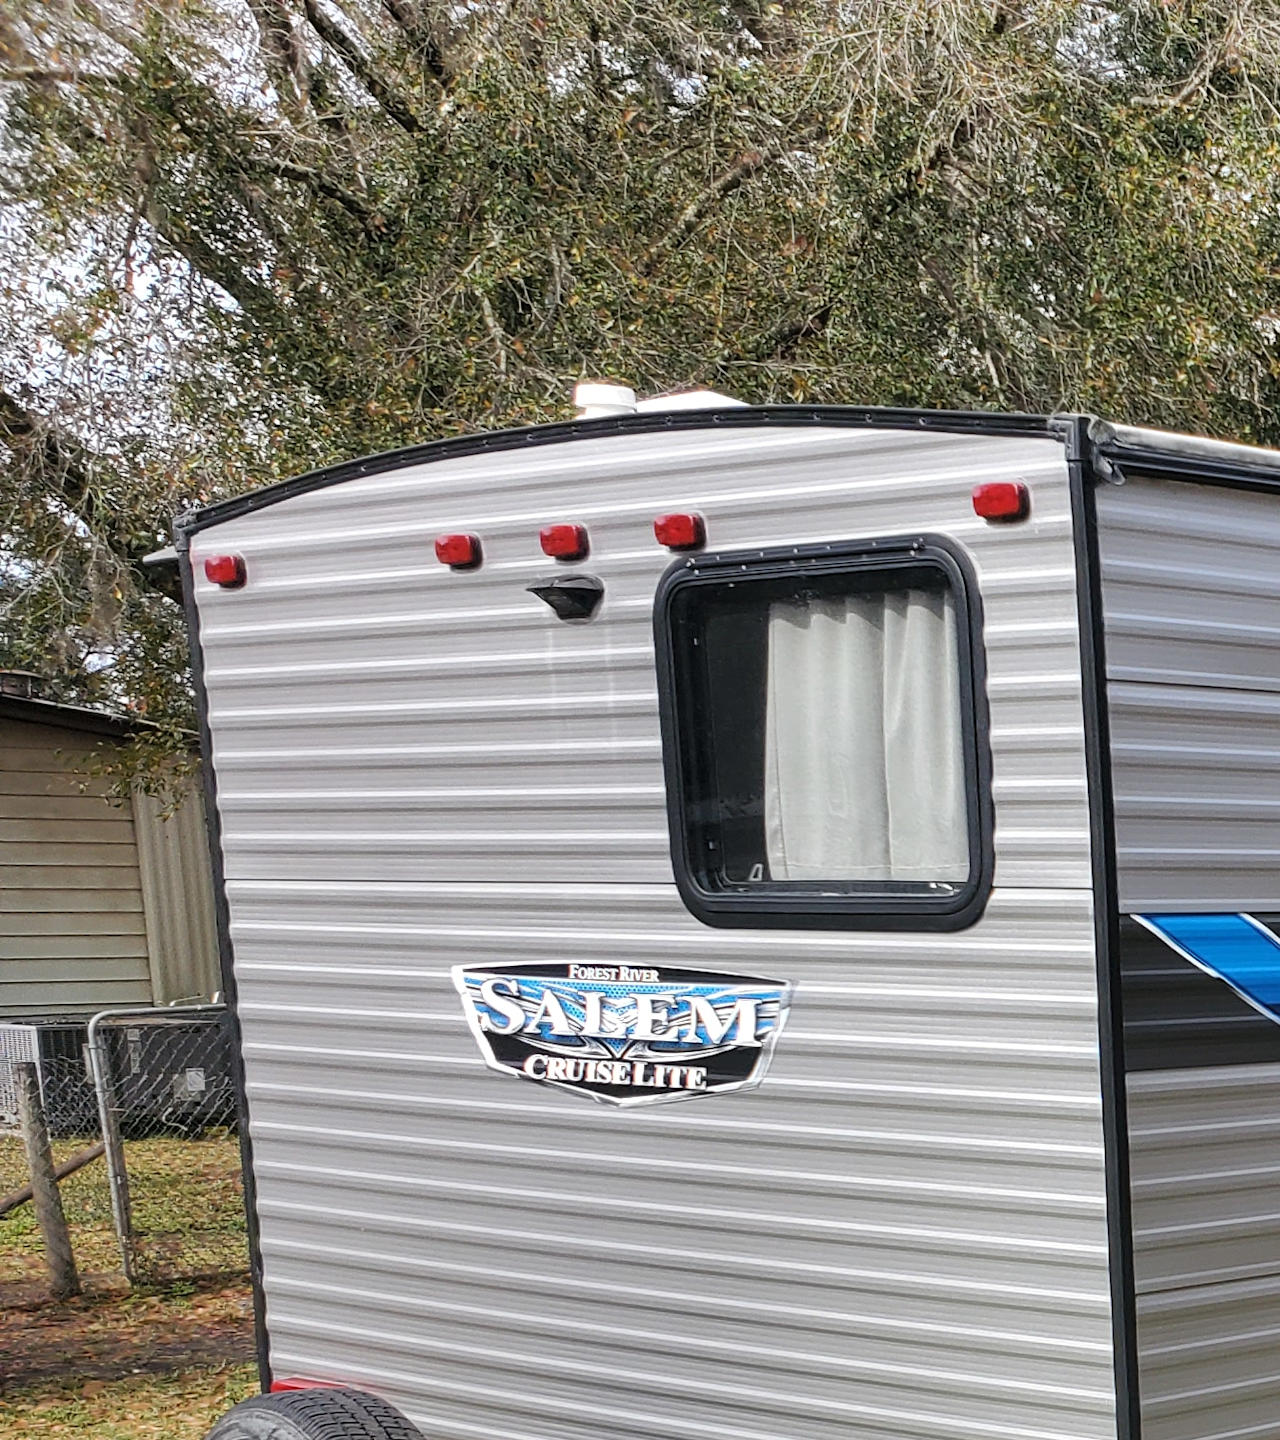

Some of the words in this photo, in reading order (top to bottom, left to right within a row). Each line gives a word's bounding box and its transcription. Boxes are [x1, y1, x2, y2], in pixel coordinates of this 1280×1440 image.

[569, 964, 619, 981] FOREST
[619, 966, 660, 982] RIVER
[478, 977, 765, 1048] SALEM
